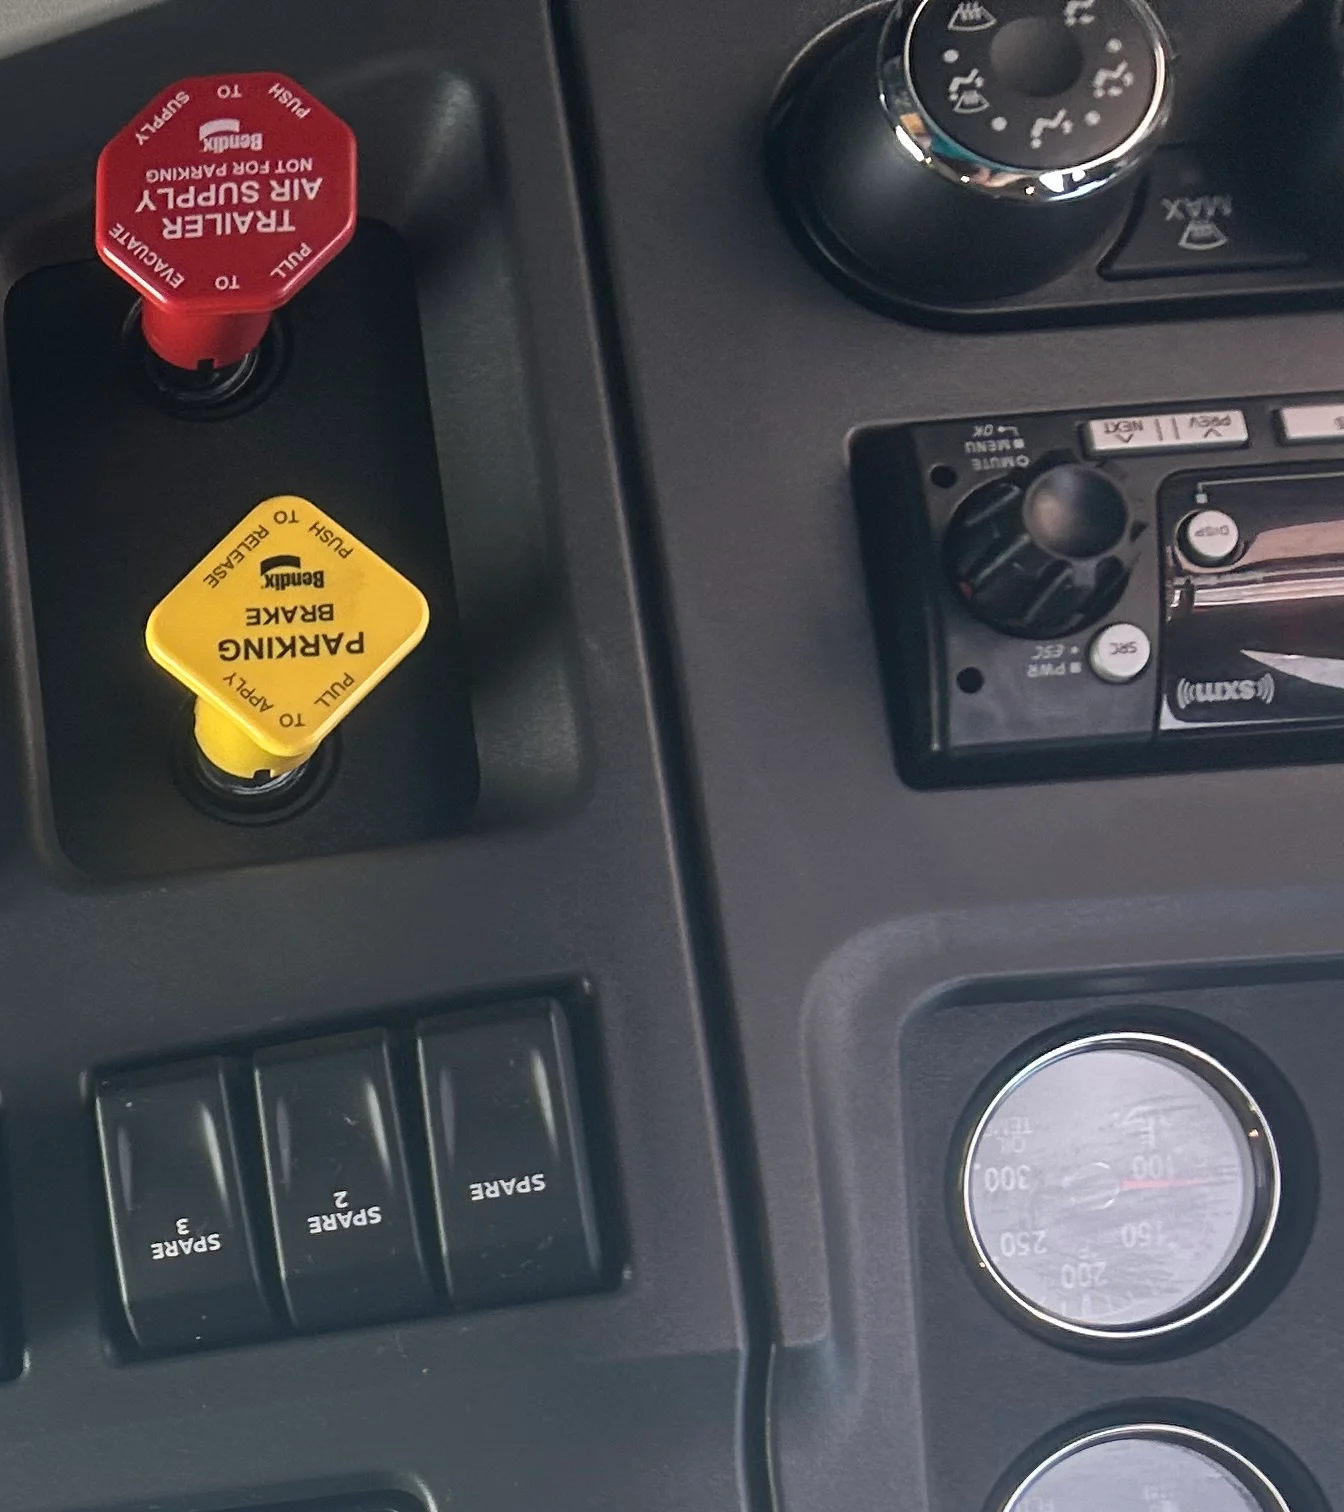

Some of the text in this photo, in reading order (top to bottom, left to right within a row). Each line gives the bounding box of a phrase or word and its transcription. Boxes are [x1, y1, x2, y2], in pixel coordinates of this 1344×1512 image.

[134, 83, 311, 145] PUSH TO SUPPLY
[202, 133, 263, 153] Bendix
[146, 157, 312, 183] NOT FOR PARKING
[135, 177, 323, 212] AIR SUPPLY
[1161, 197, 1232, 221] MAX
[162, 209, 295, 239] TRAILER
[108, 222, 312, 290] PULL TO EVACUATE
[1103, 420, 1143, 434] NEXT
[1189, 415, 1231, 429] PREV
[964, 438, 1010, 453] MENU
[971, 455, 1014, 470] MUTE
[202, 510, 354, 588] PUSH TO RELEASE
[263, 570, 324, 591] Bendix
[245, 604, 334, 626] BRAKE
[218, 631, 364, 661] PARKING
[1031, 643, 1064, 659] ESC
[1109, 642, 1137, 655] SRC
[1027, 662, 1066, 678] PWR
[222, 671, 355, 727] PULL TO APPLY
[1194, 679, 1255, 701] sxm
[984, 1164, 1031, 1191] 300
[1132, 1155, 1174, 1179] 100
[469, 1172, 546, 1201] SPARE
[333, 1191, 348, 1208] 2
[175, 1217, 189, 1235] 3
[307, 1205, 382, 1234] SPARE
[150, 1232, 221, 1260] SPARE
[1000, 1229, 1047, 1257] 250
[1120, 1223, 1163, 1247] 150
[1061, 1261, 1107, 1288] 200
